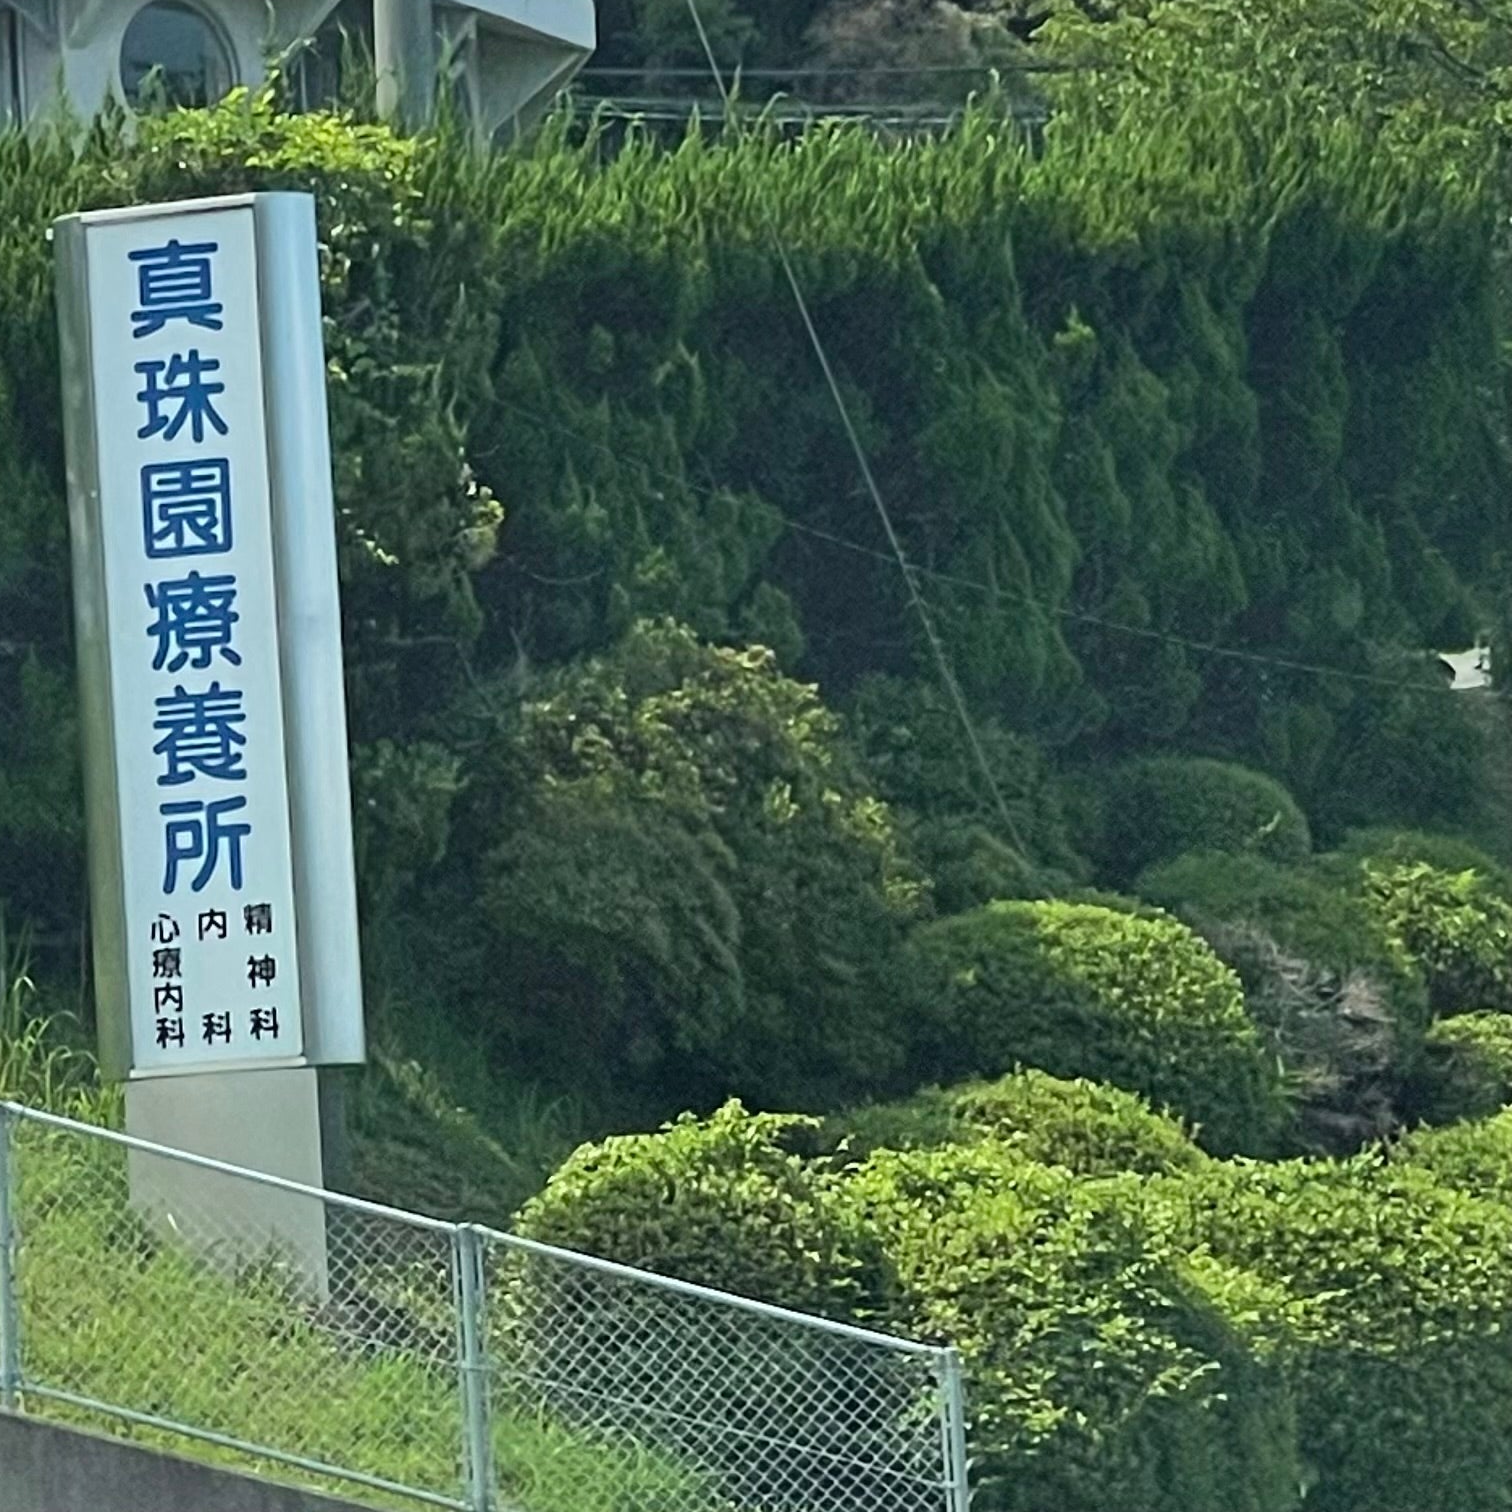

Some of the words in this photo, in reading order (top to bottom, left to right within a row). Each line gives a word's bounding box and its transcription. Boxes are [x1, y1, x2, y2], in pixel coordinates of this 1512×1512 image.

[127, 239, 251, 896] 真珠園療養所
[151, 913, 185, 1049] 心療内科
[243, 903, 279, 1040] 精神科
